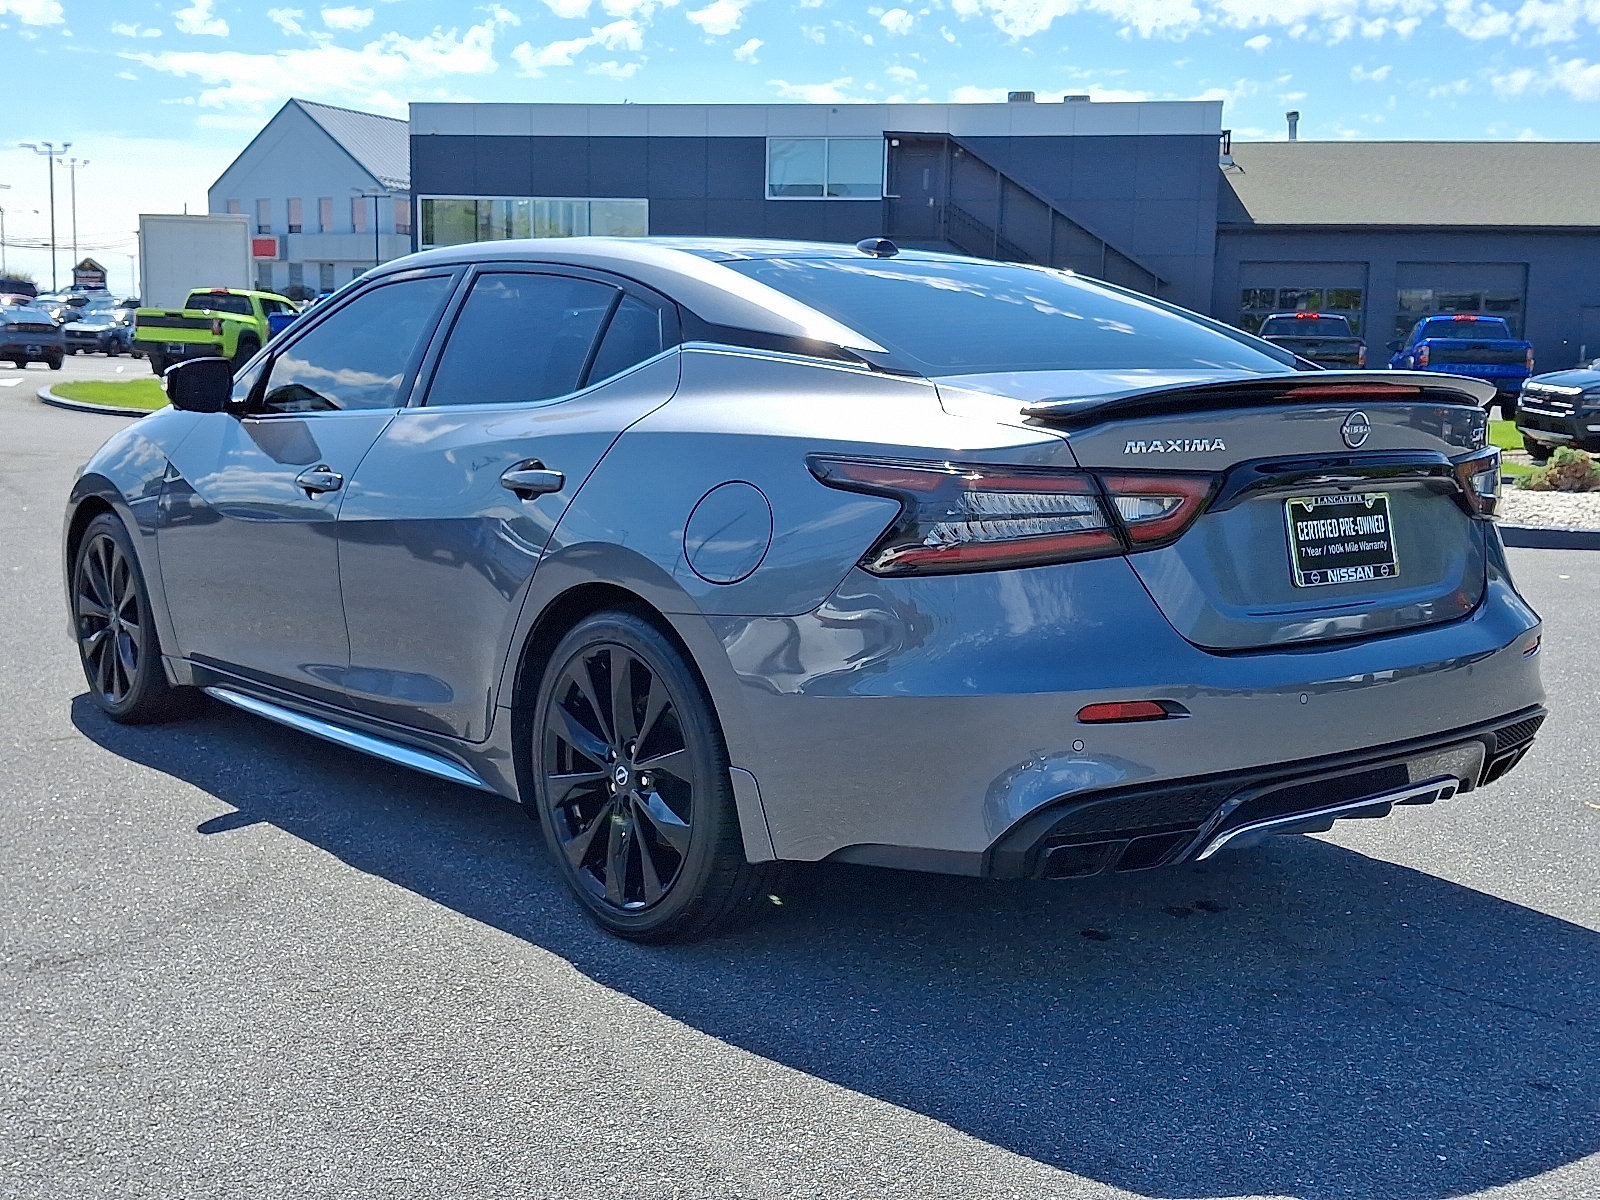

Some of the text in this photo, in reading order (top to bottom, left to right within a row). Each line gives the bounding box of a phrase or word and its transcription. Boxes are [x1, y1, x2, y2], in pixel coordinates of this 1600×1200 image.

[1123, 438, 1226, 454] MAXIMA
[1317, 494, 1363, 505] LANCASTER
[1297, 514, 1385, 541] CERTIFIED PRE-OWNED
[1301, 547, 1306, 557] 7
[1306, 546, 1322, 557] Year
[1328, 544, 1344, 555] 100k
[1345, 542, 1359, 553] Mile
[1359, 539, 1388, 552] Warranty
[1327, 565, 1374, 583] NISSAN
